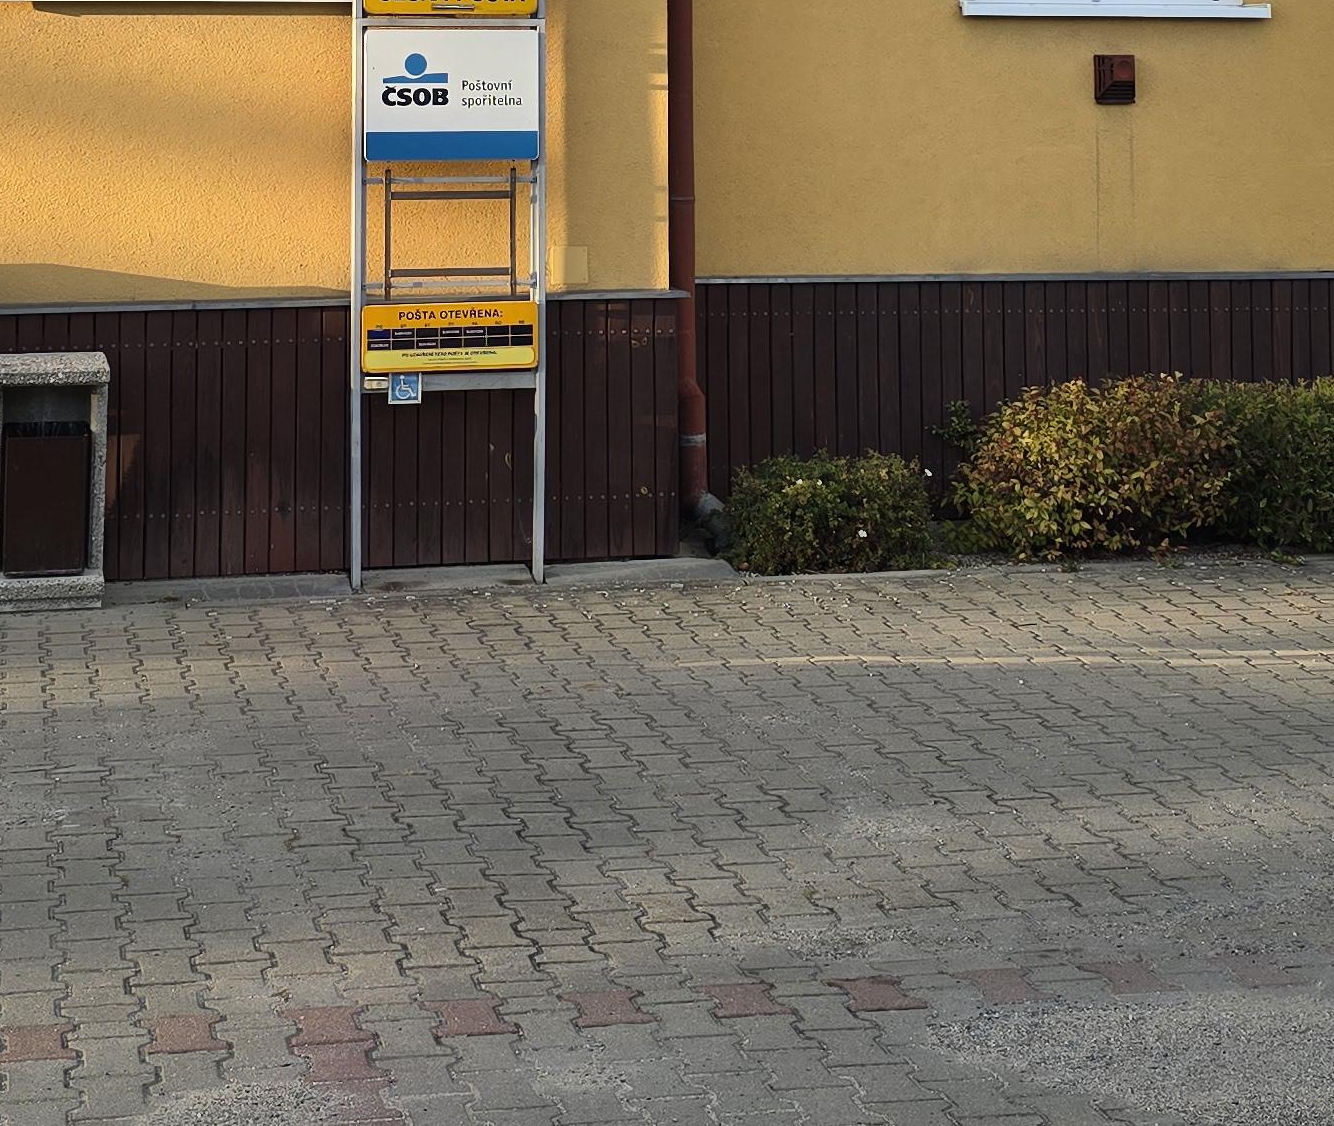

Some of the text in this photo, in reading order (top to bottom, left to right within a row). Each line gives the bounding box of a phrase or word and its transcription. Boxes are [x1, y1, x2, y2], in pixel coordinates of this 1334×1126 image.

[461, 80, 513, 92] Poštovní
[381, 86, 449, 107] ČSOB
[461, 94, 522, 108] spořitelna
[398, 306, 503, 321] POŠTA OTEVŘENA:
